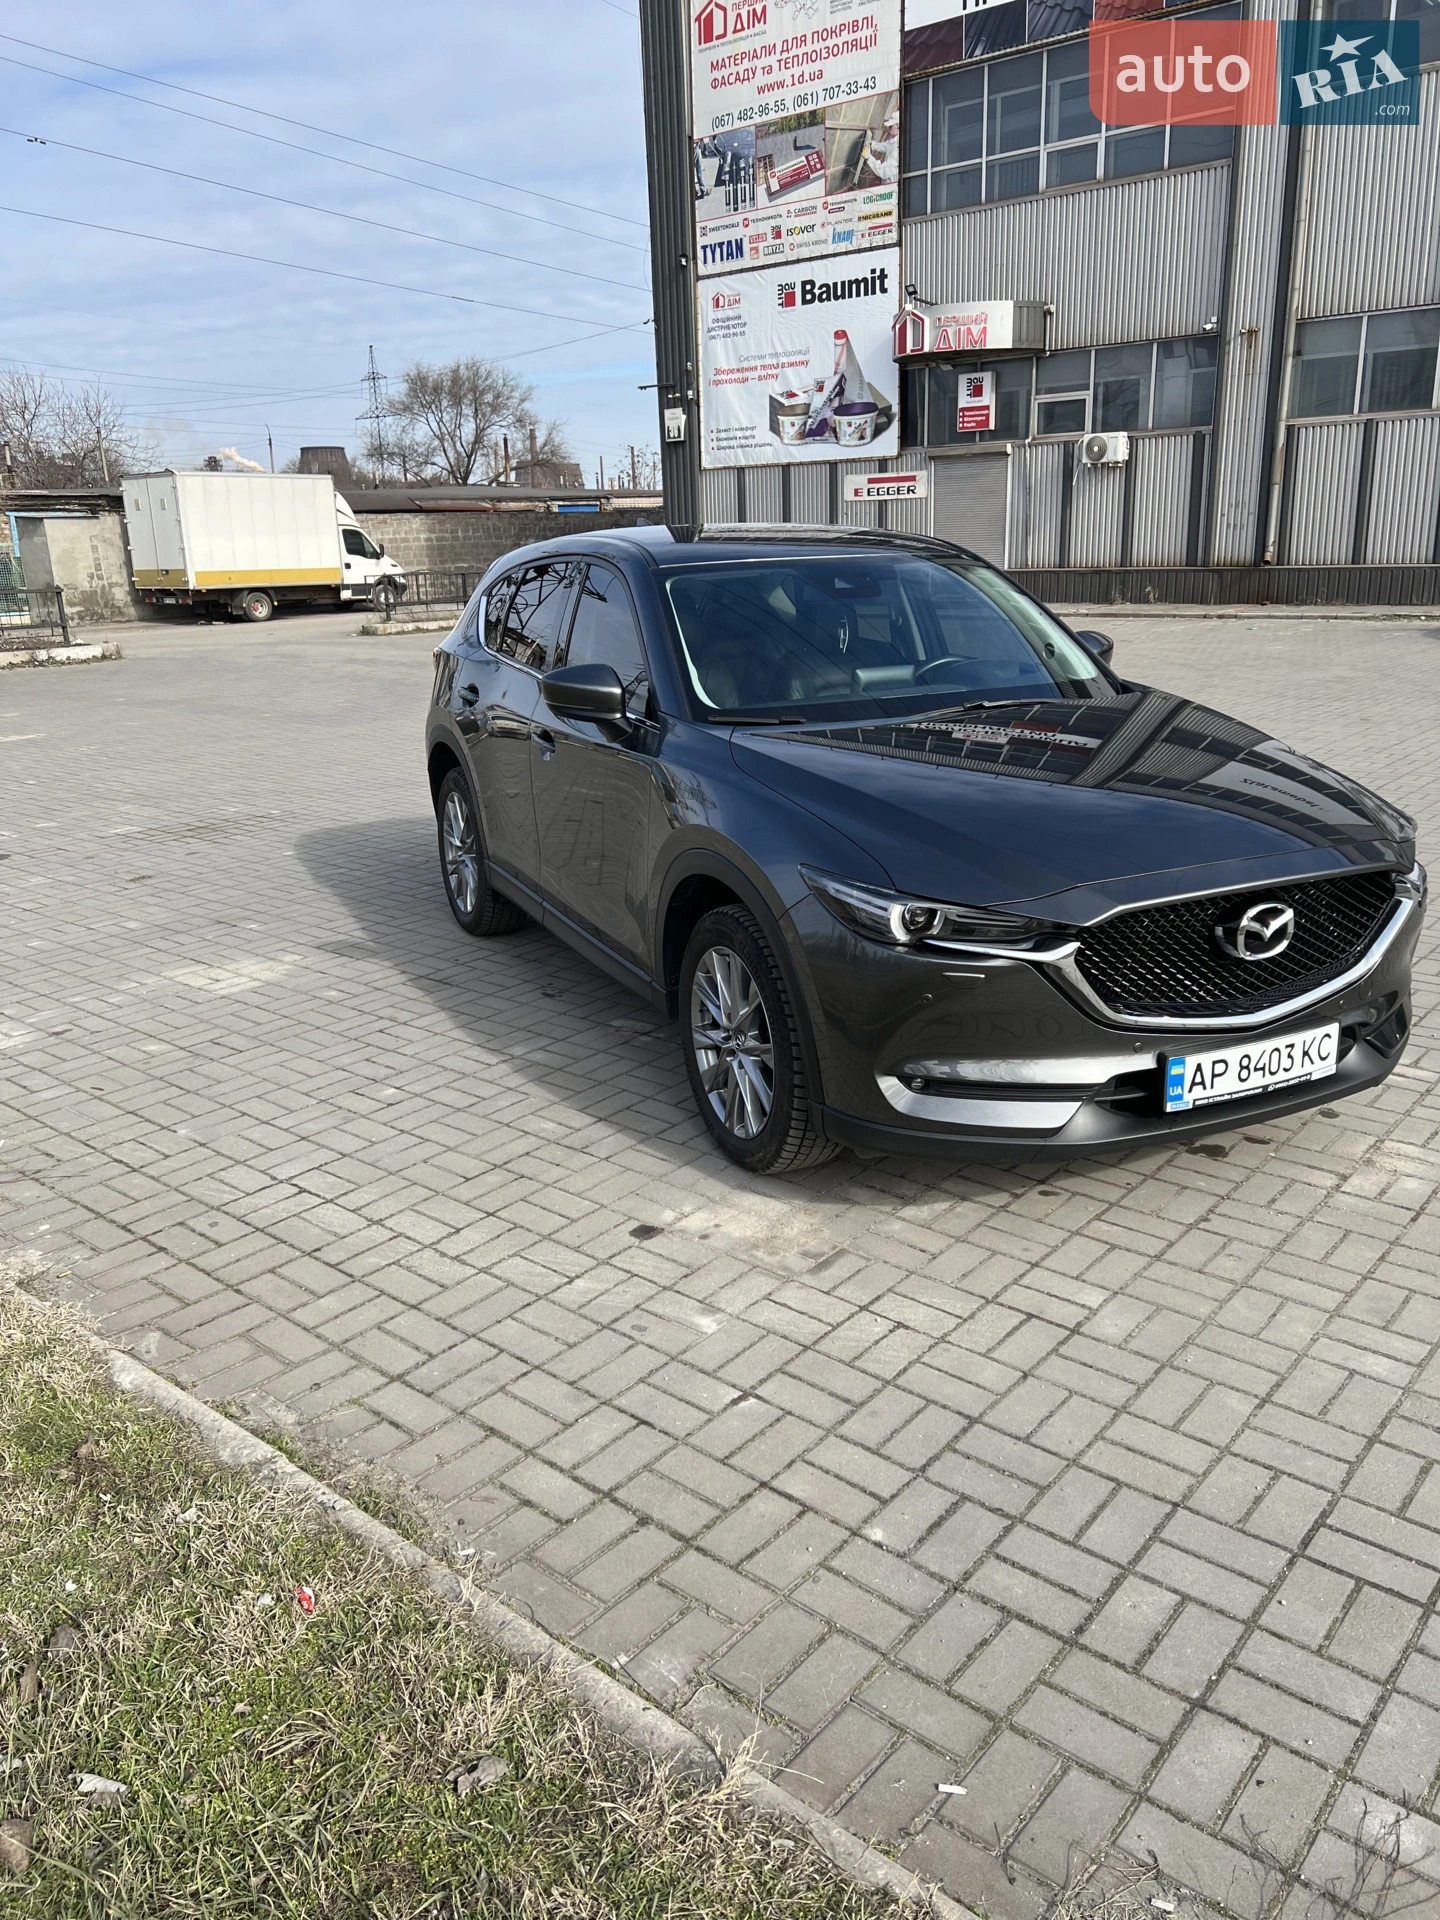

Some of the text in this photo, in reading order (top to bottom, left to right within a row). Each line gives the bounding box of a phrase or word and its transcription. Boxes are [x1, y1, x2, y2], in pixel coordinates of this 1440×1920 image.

[732, 4, 767, 35] ДІМ
[710, 15, 878, 73] МАТЕРІАЛИ ДЛЯ ПОКРІВЛІ,
[710, 28, 878, 91] ФАСАДУ та ТЕПЛОІЗОЛЯЦІЇ
[757, 68, 823, 96] www.1d.ua
[711, 76, 878, 133] (067) 482-96-55, (061) 707-33-43
[793, 204, 818, 214] CARBON
[708, 221, 740, 233] SWEETONDALE
[868, 228, 893, 237] EGGER
[749, 233, 767, 244] VELUX
[796, 238, 828, 249] SWISS KRONO
[701, 237, 744, 265] TYTAN
[763, 243, 784, 256] BRYZA
[800, 268, 889, 305] Baumit
[727, 297, 741, 307] ДІМ
[934, 311, 989, 327] ПЕРШИЙ
[934, 325, 989, 351] ДІМ
[739, 347, 810, 363] Системи теплоізоляції
[713, 359, 810, 377] Збереження тепла взимку
[712, 376, 749, 388] прохолоди
[758, 371, 780, 382] влітку
[867, 484, 917, 497] EGGER
[1188, 1058, 1229, 1094] AP
[1237, 1043, 1295, 1083] 8403
[1301, 1032, 1332, 1069] KC
[1169, 1086, 1183, 1096] UA
